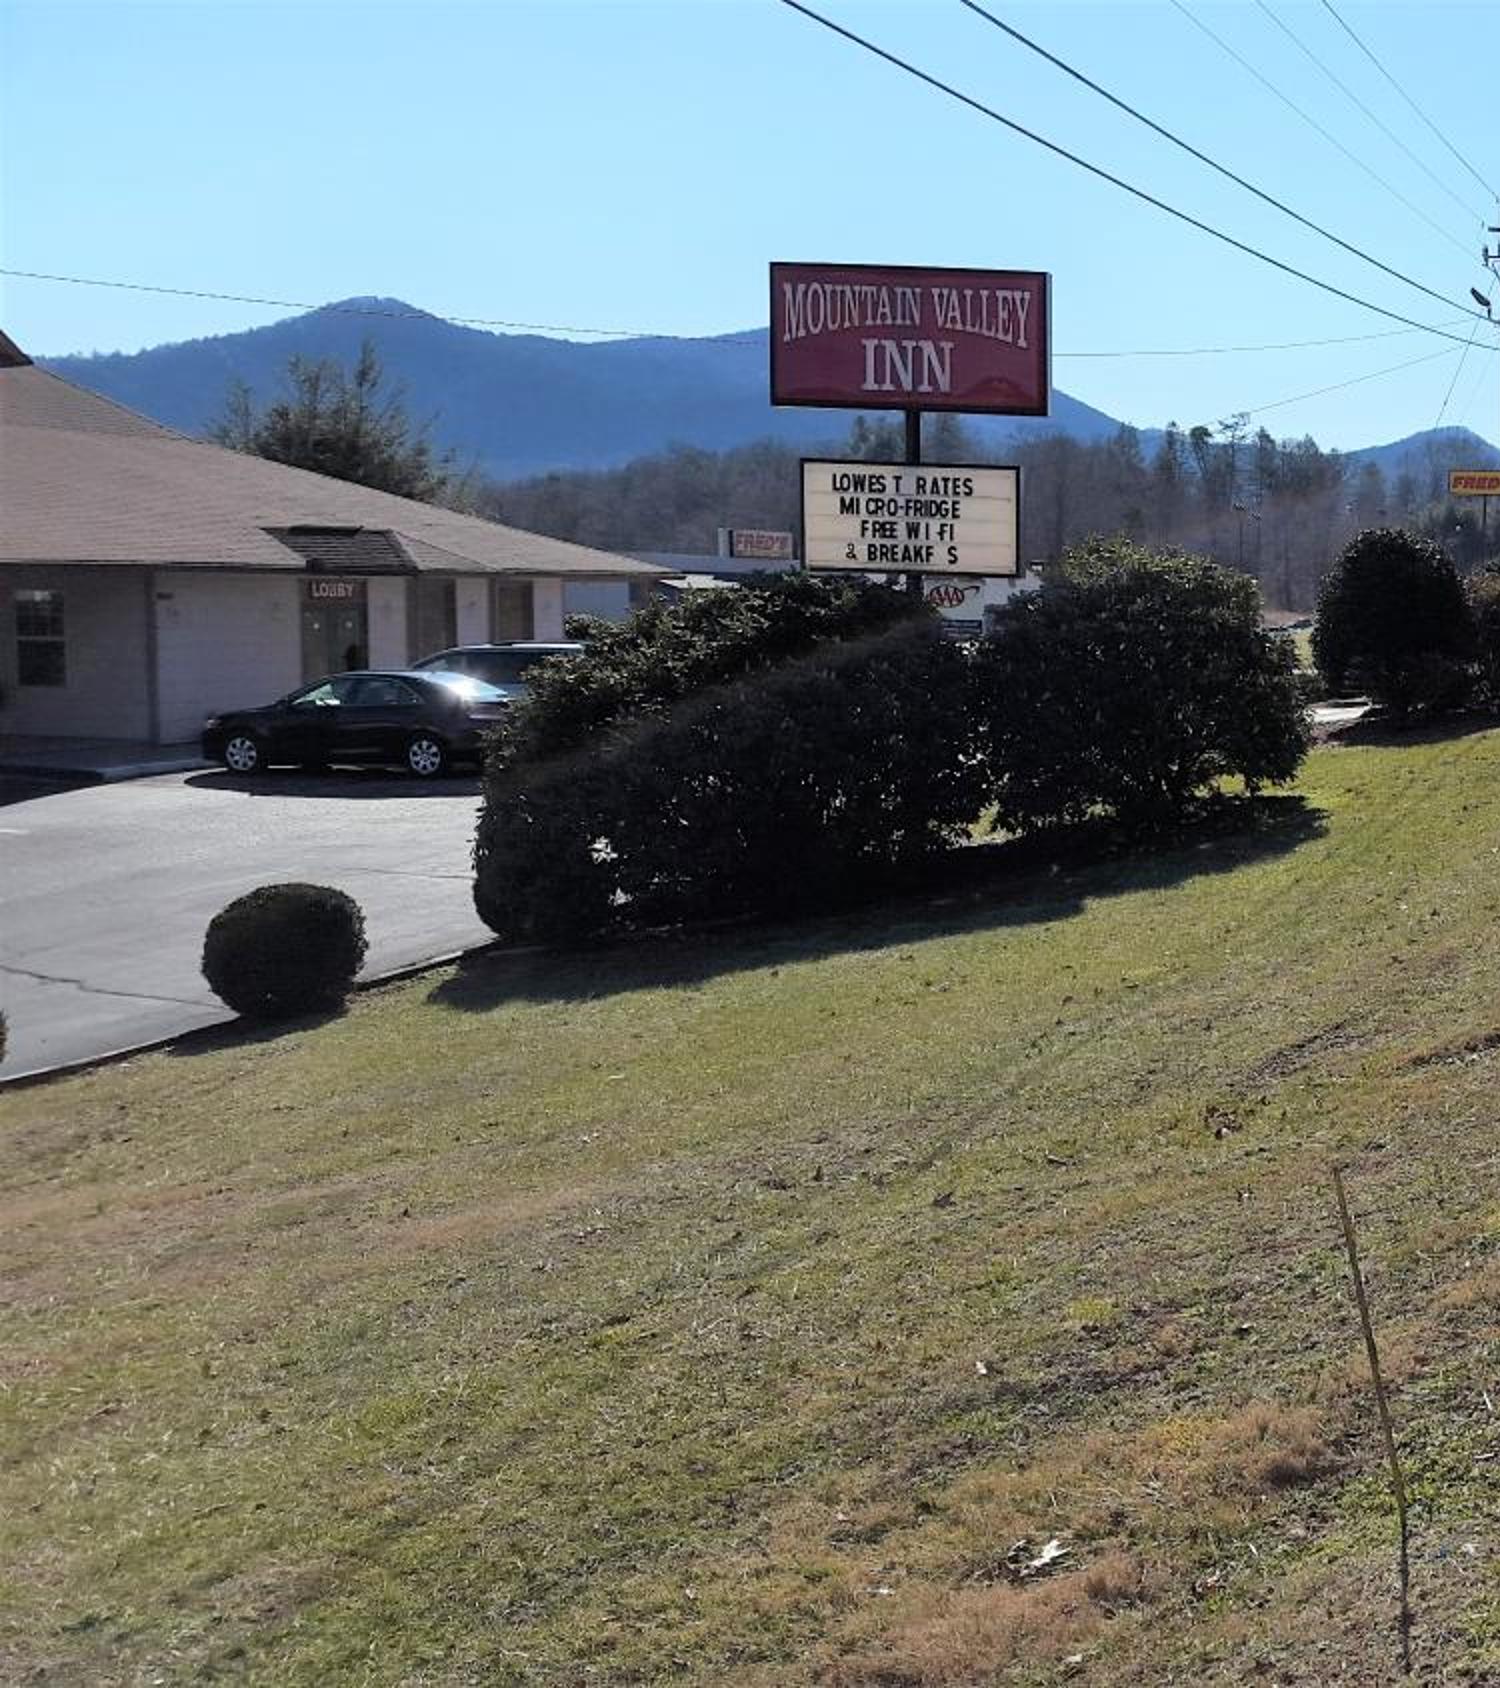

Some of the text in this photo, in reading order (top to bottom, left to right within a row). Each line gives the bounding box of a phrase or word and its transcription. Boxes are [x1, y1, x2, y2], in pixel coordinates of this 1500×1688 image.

[783, 282, 1032, 348] MOUNTAIN VALLEY
[861, 338, 954, 392] INN
[832, 473, 974, 496] LOWEST RATES
[839, 496, 961, 518] MICRO-FRIDGE
[860, 520, 898, 539] FREE
[845, 543, 858, 560] &
[312, 581, 353, 597] LOBBY
